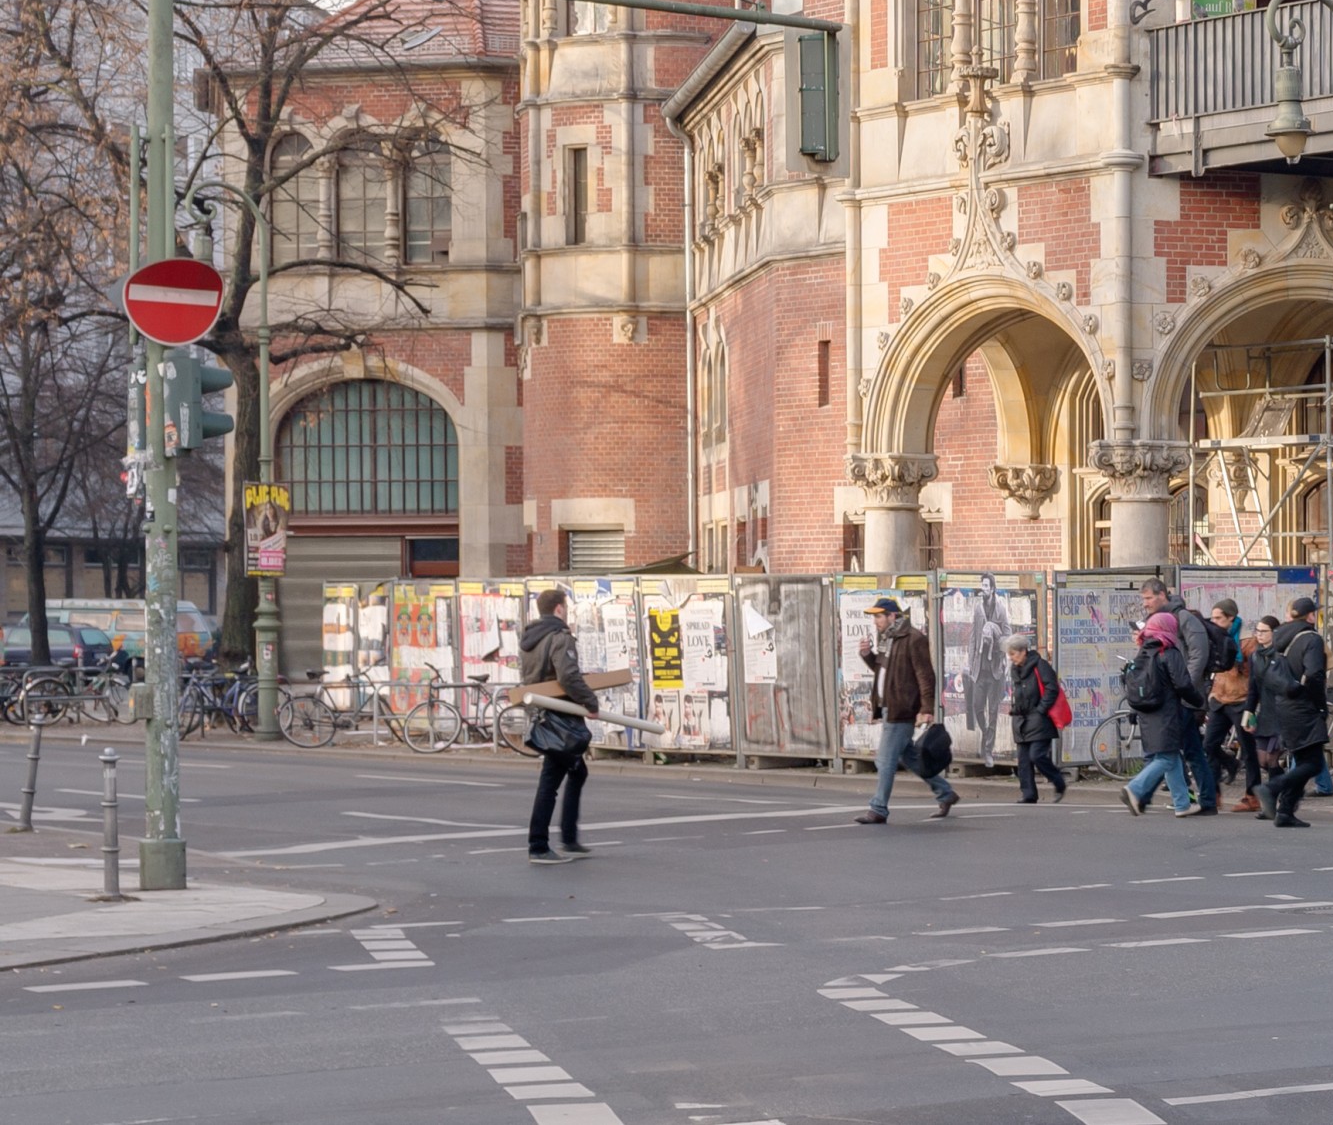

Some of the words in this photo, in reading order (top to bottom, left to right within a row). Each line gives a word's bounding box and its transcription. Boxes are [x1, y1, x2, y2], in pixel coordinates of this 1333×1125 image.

[1205, 0, 1223, 12] auf
[607, 618, 625, 627] SPREAD
[686, 621, 710, 630] SPREAD
[846, 624, 871, 637] LOVE
[608, 631, 625, 643] LOVE
[687, 635, 710, 648] LOVE
